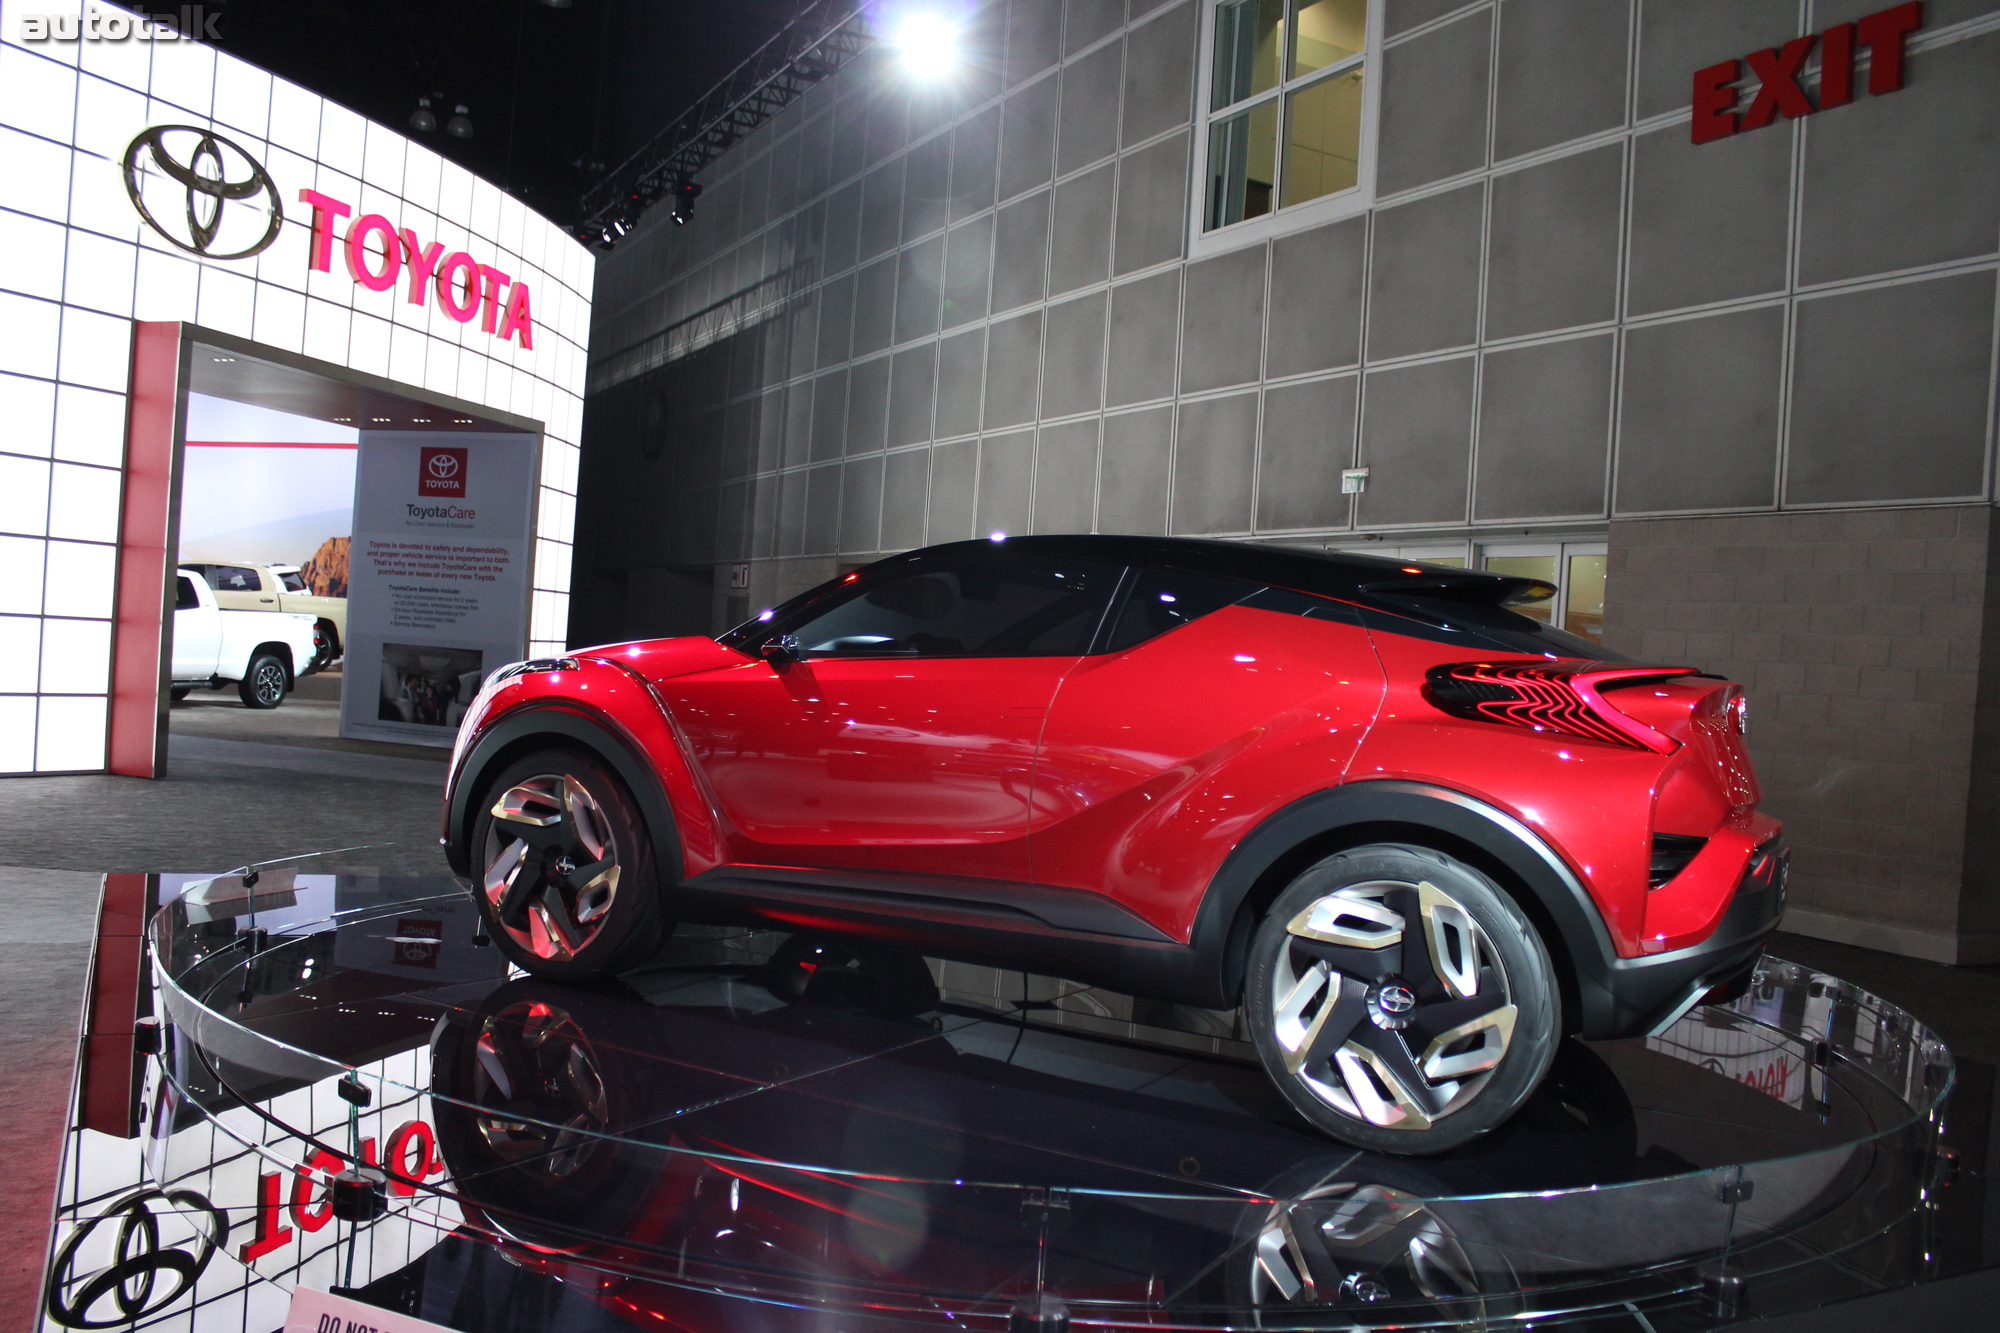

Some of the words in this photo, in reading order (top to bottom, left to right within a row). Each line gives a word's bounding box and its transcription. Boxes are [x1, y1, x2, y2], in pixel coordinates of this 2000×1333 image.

[1691, 1, 1924, 145] EXIT
[298, 188, 534, 351] TOYOTA
[425, 480, 460, 490] TOYOTA
[406, 504, 476, 521] ToyotaCare
[370, 541, 390, 549] Toyota
[456, 555, 485, 563] important
[442, 563, 477, 572] ToyotaCare
